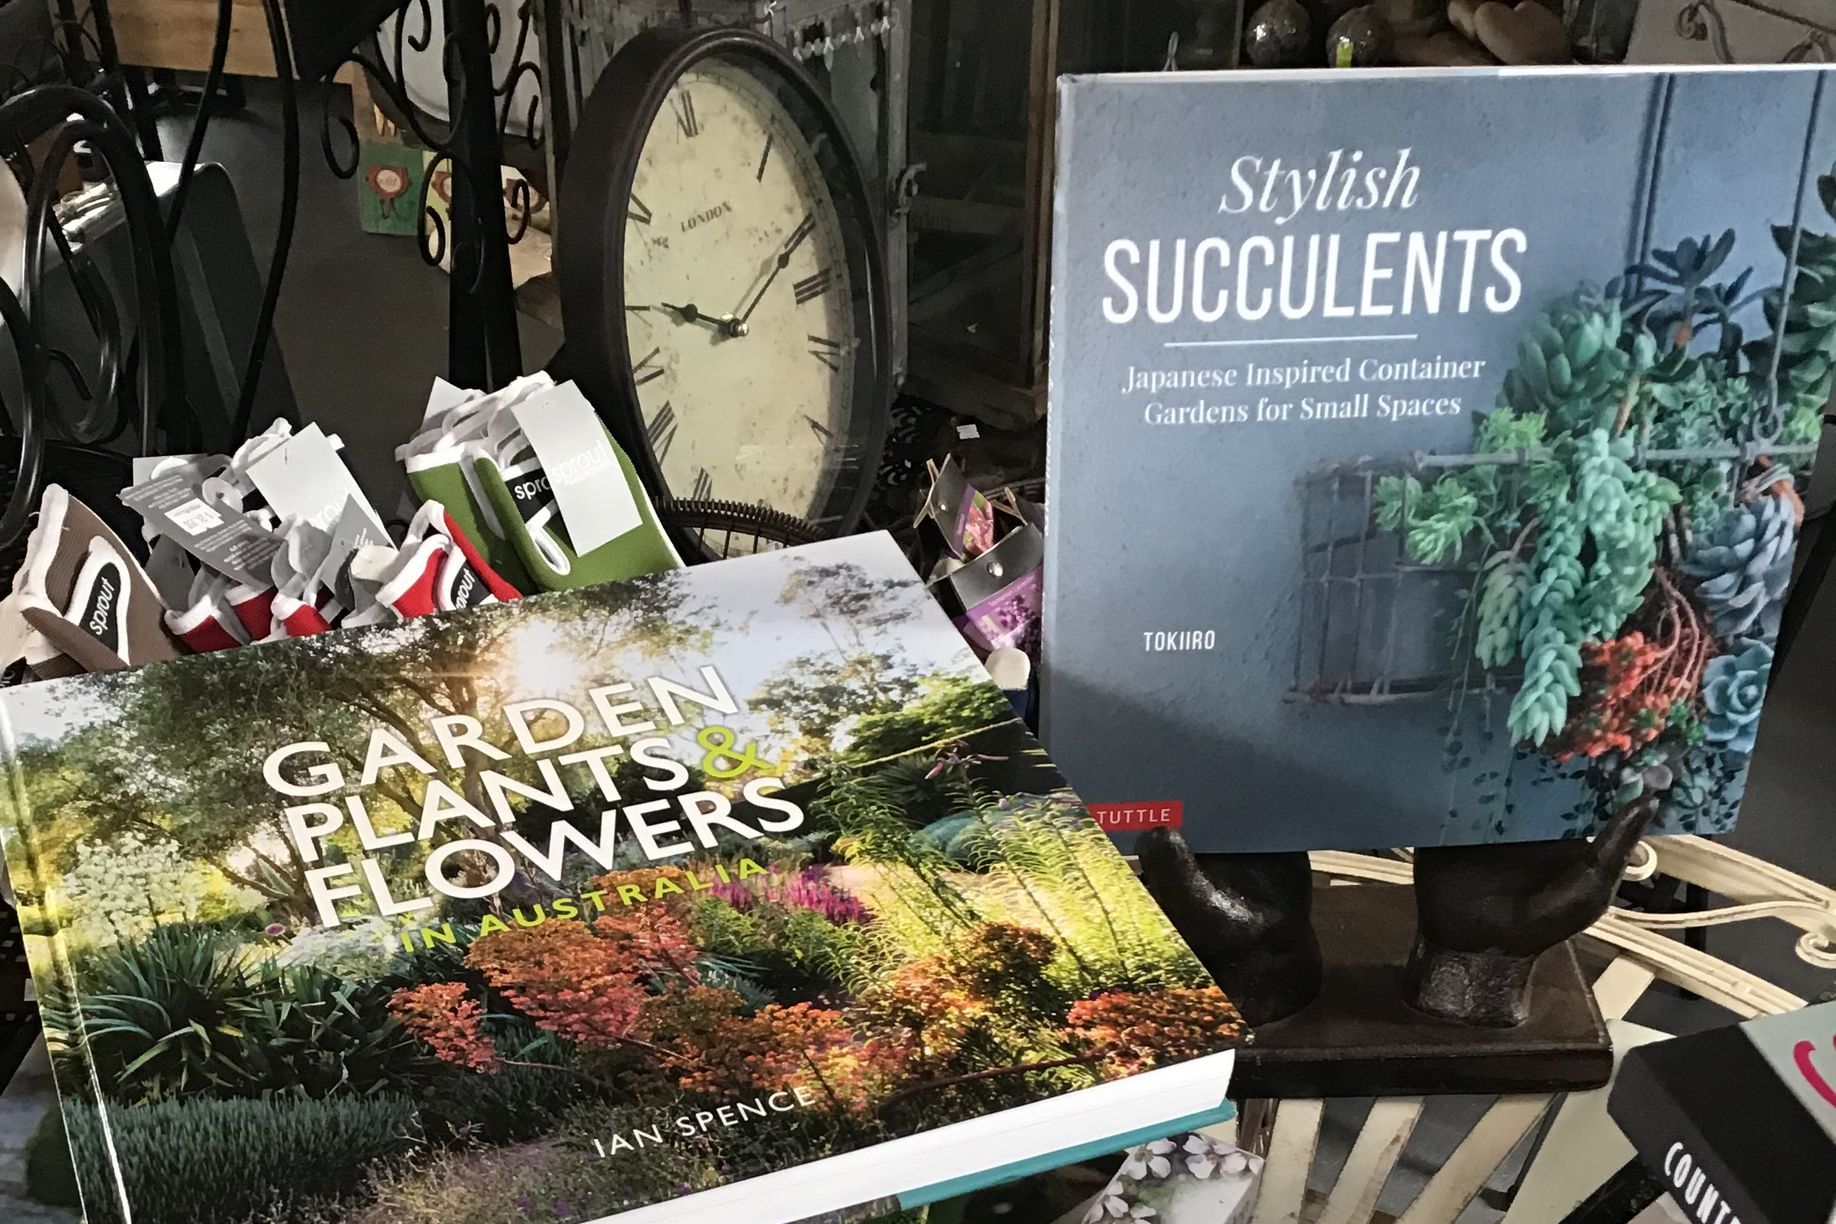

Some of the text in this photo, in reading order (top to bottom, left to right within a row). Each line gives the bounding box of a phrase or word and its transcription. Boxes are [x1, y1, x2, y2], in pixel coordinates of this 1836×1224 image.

[680, 200, 732, 233] LONDON
[1218, 146, 1421, 225] Stylish
[1102, 228, 1528, 324] SUCCULENTS
[1122, 354, 1487, 393] Japanese Inspired Container
[1144, 394, 1462, 426] Gardens for Small Spaces
[514, 475, 552, 500] spro
[89, 576, 116, 636] sprout
[1144, 630, 1216, 651] TOKIIRO
[263, 665, 739, 797] GARDEN
[284, 725, 780, 862] PLANTS &
[1098, 808, 1171, 825] TUTTLE
[304, 776, 805, 928] FLOWERS
[400, 857, 768, 954] IN AUSTRALIA
[594, 1086, 817, 1159] IAN SPENCE
